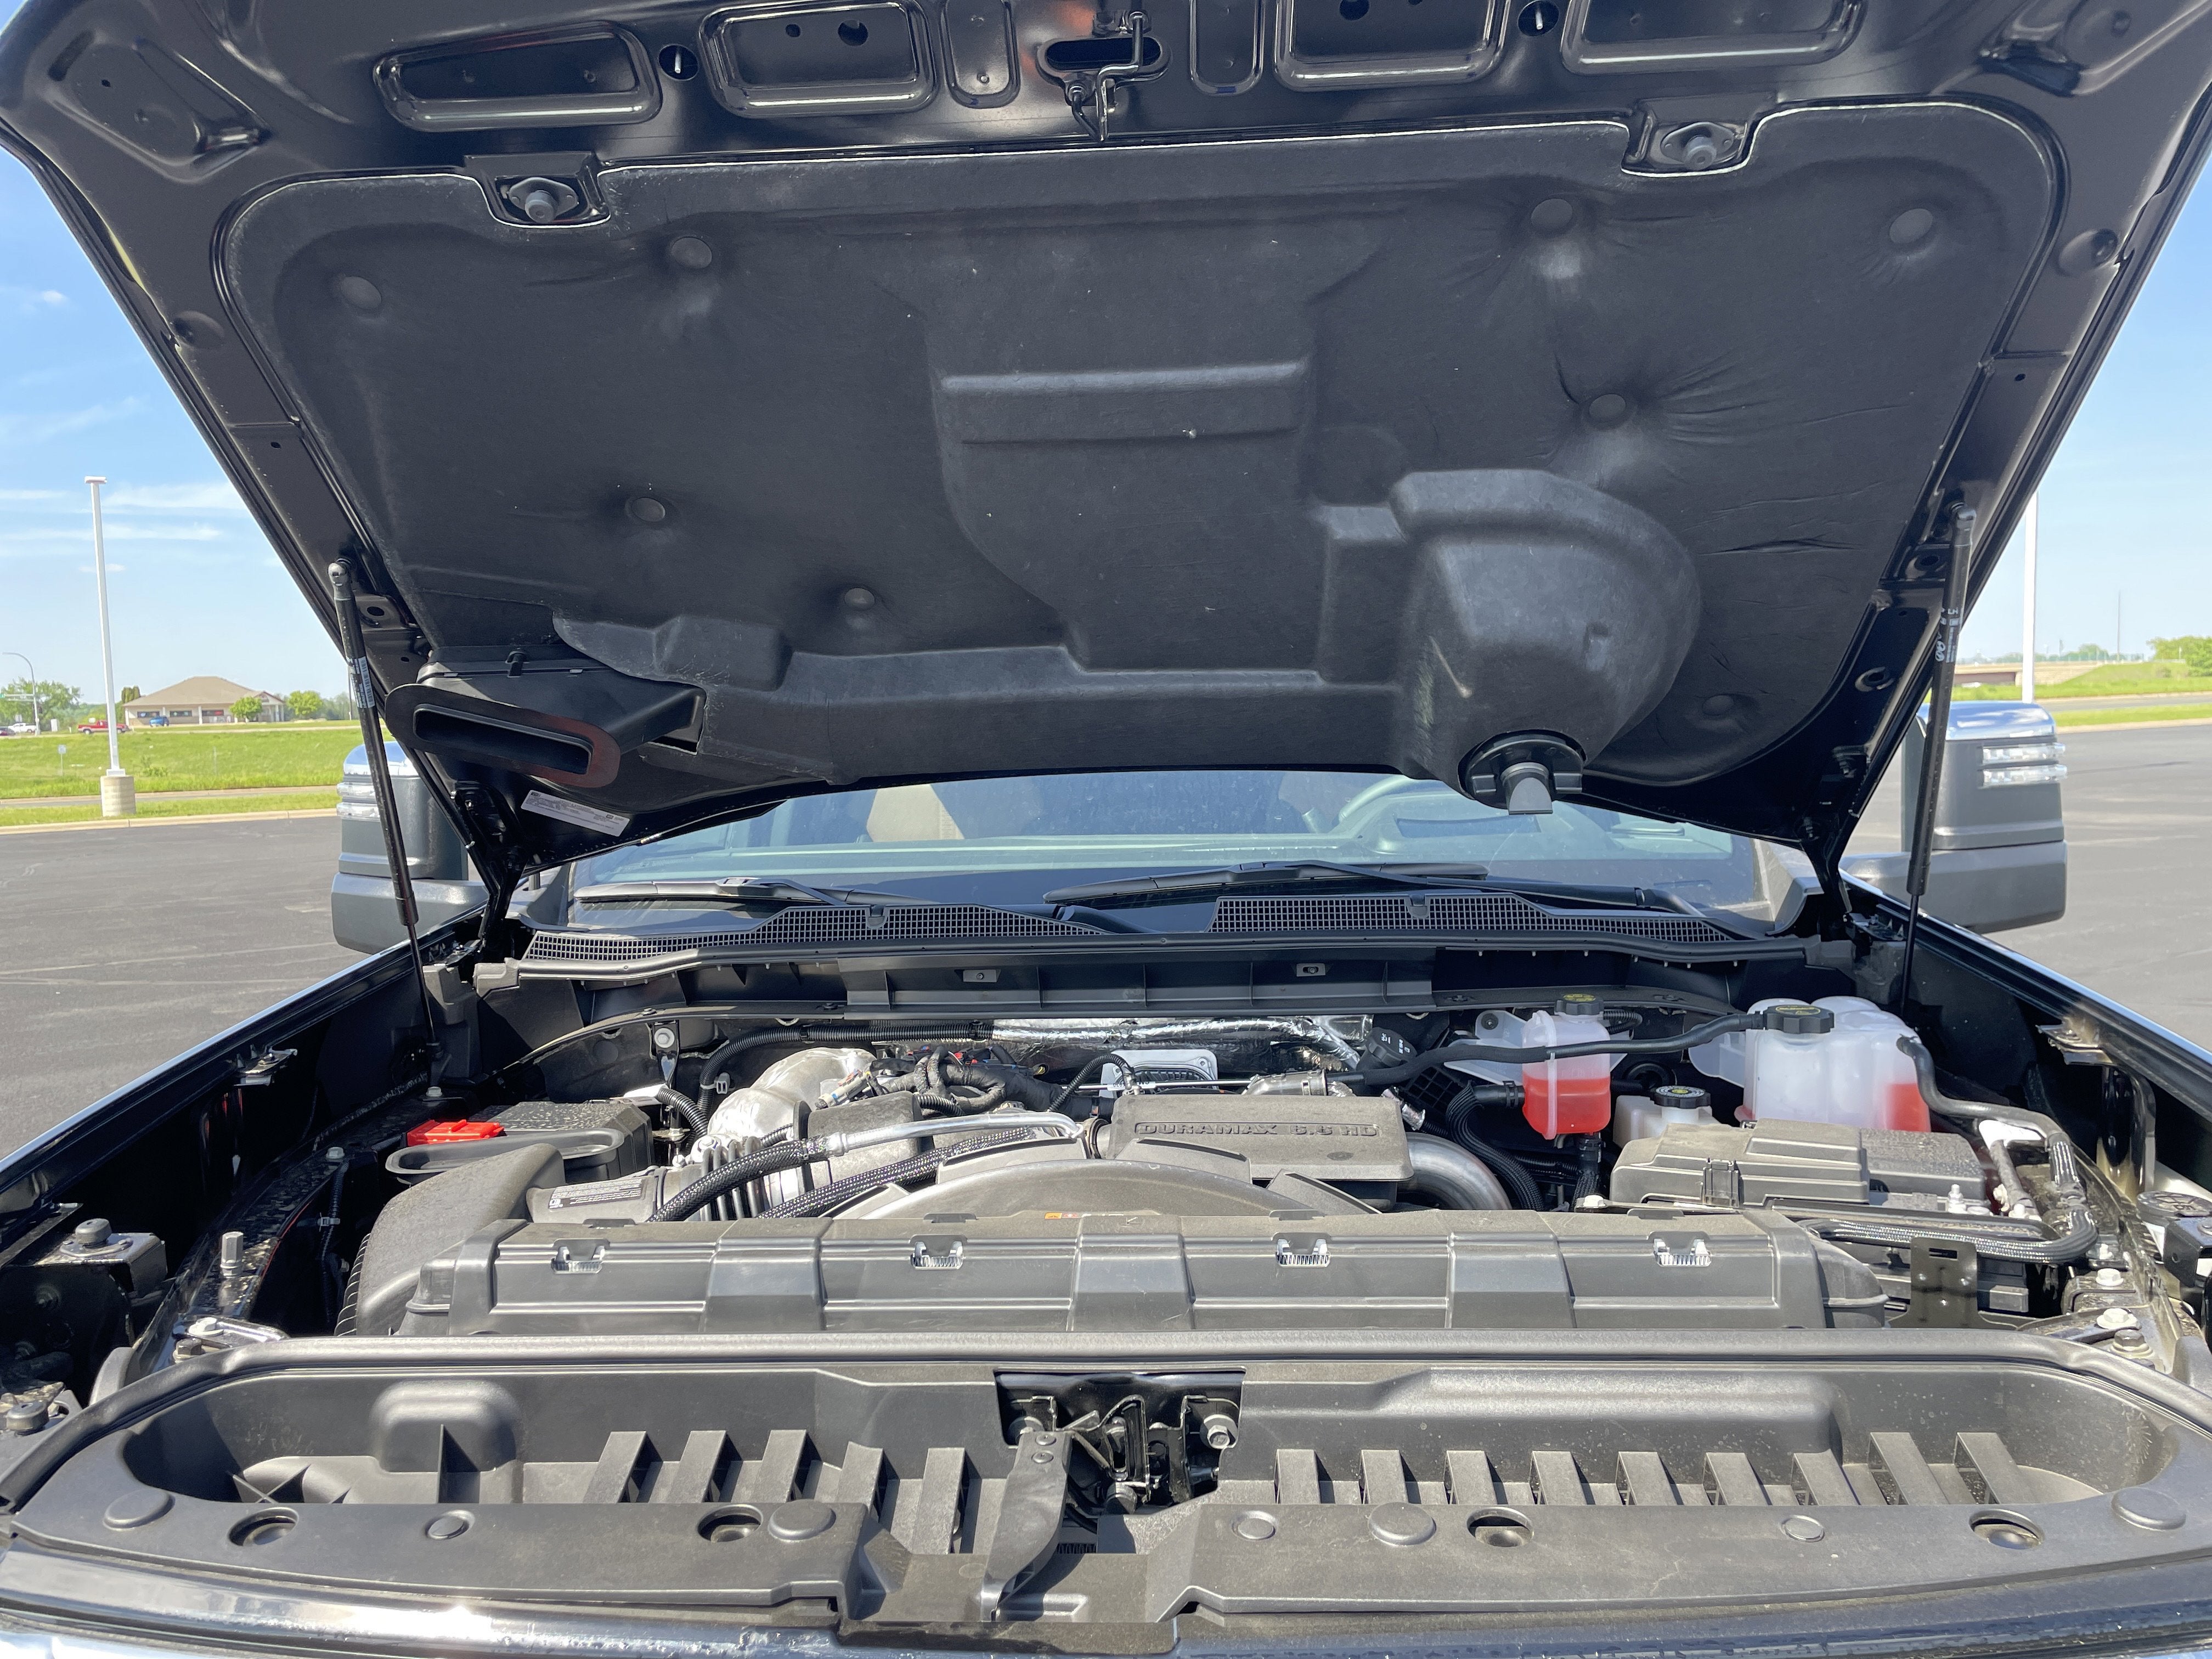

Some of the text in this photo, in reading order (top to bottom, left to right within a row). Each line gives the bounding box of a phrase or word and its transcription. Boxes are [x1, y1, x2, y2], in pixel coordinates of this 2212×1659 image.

[1139, 1123, 1377, 1137] DURAMAX 6.6 HD
